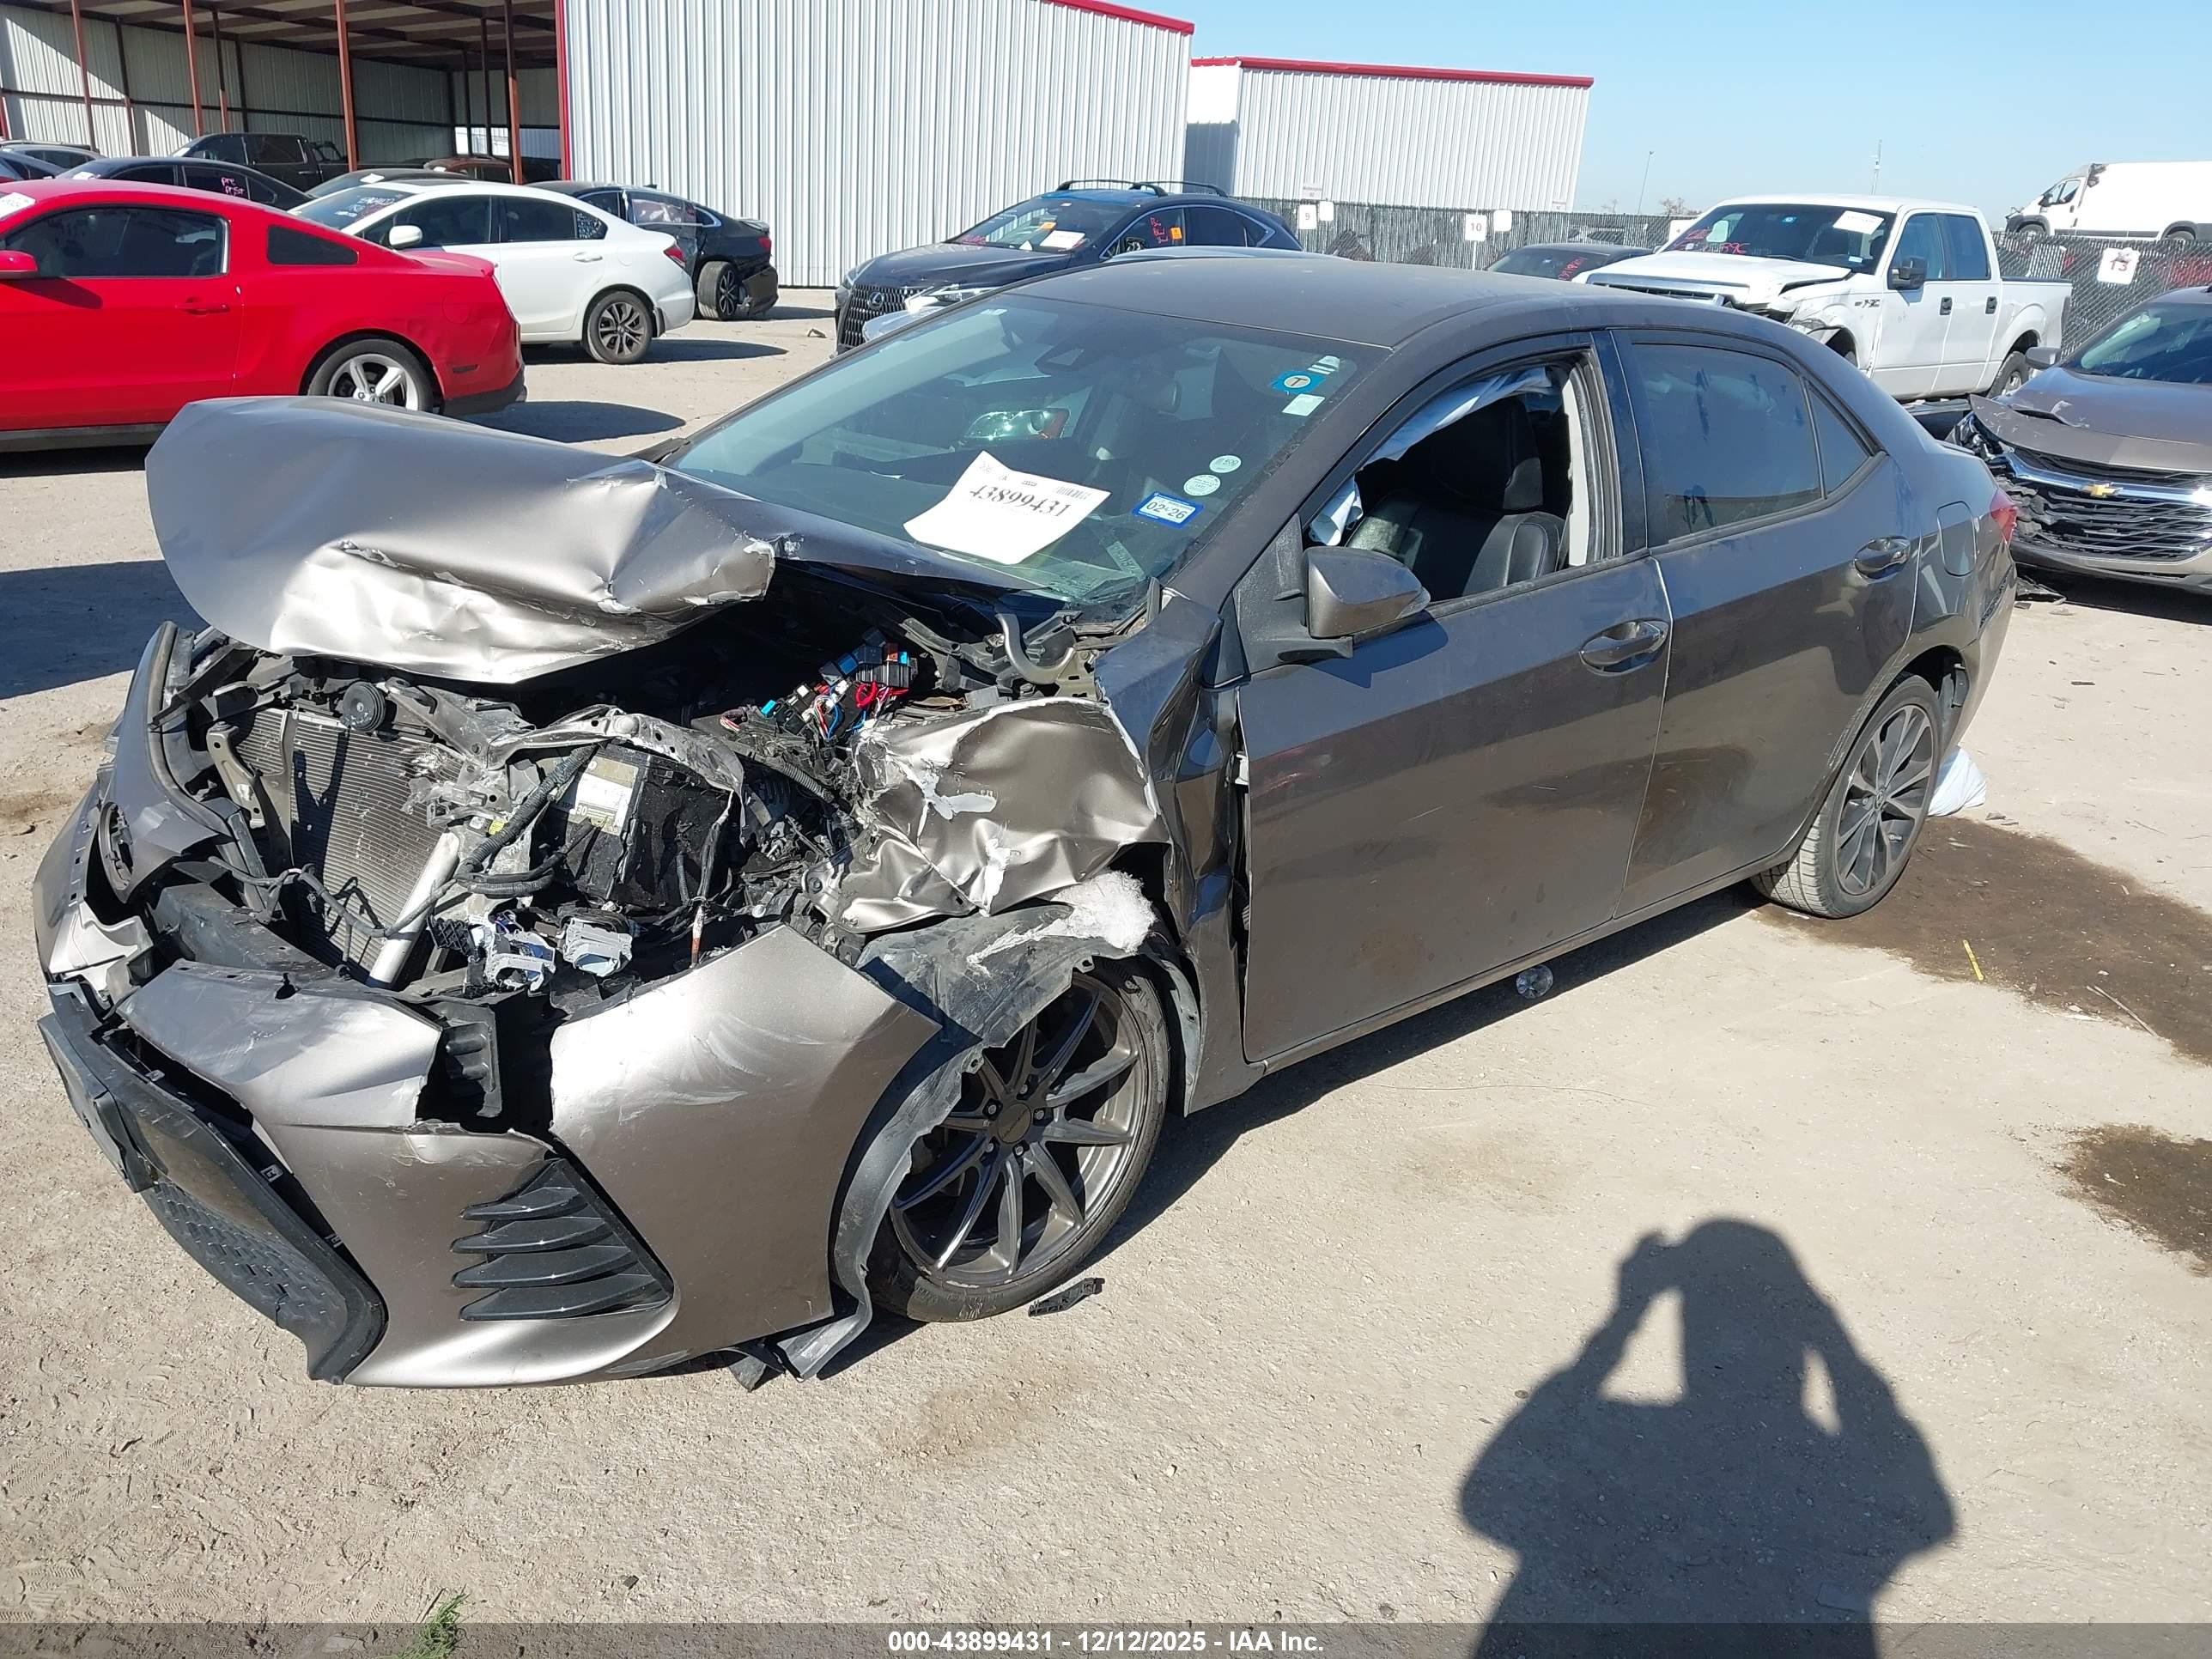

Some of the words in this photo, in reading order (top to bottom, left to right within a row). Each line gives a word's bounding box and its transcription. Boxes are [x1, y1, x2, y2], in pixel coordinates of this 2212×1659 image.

[1304, 212, 1310, 221] 9
[1470, 222, 1482, 232] 10
[2110, 259, 2128, 272] 13
[969, 483, 1072, 517] 43899431
[1146, 501, 1166, 513] 02
[1168, 507, 1188, 520] 26
